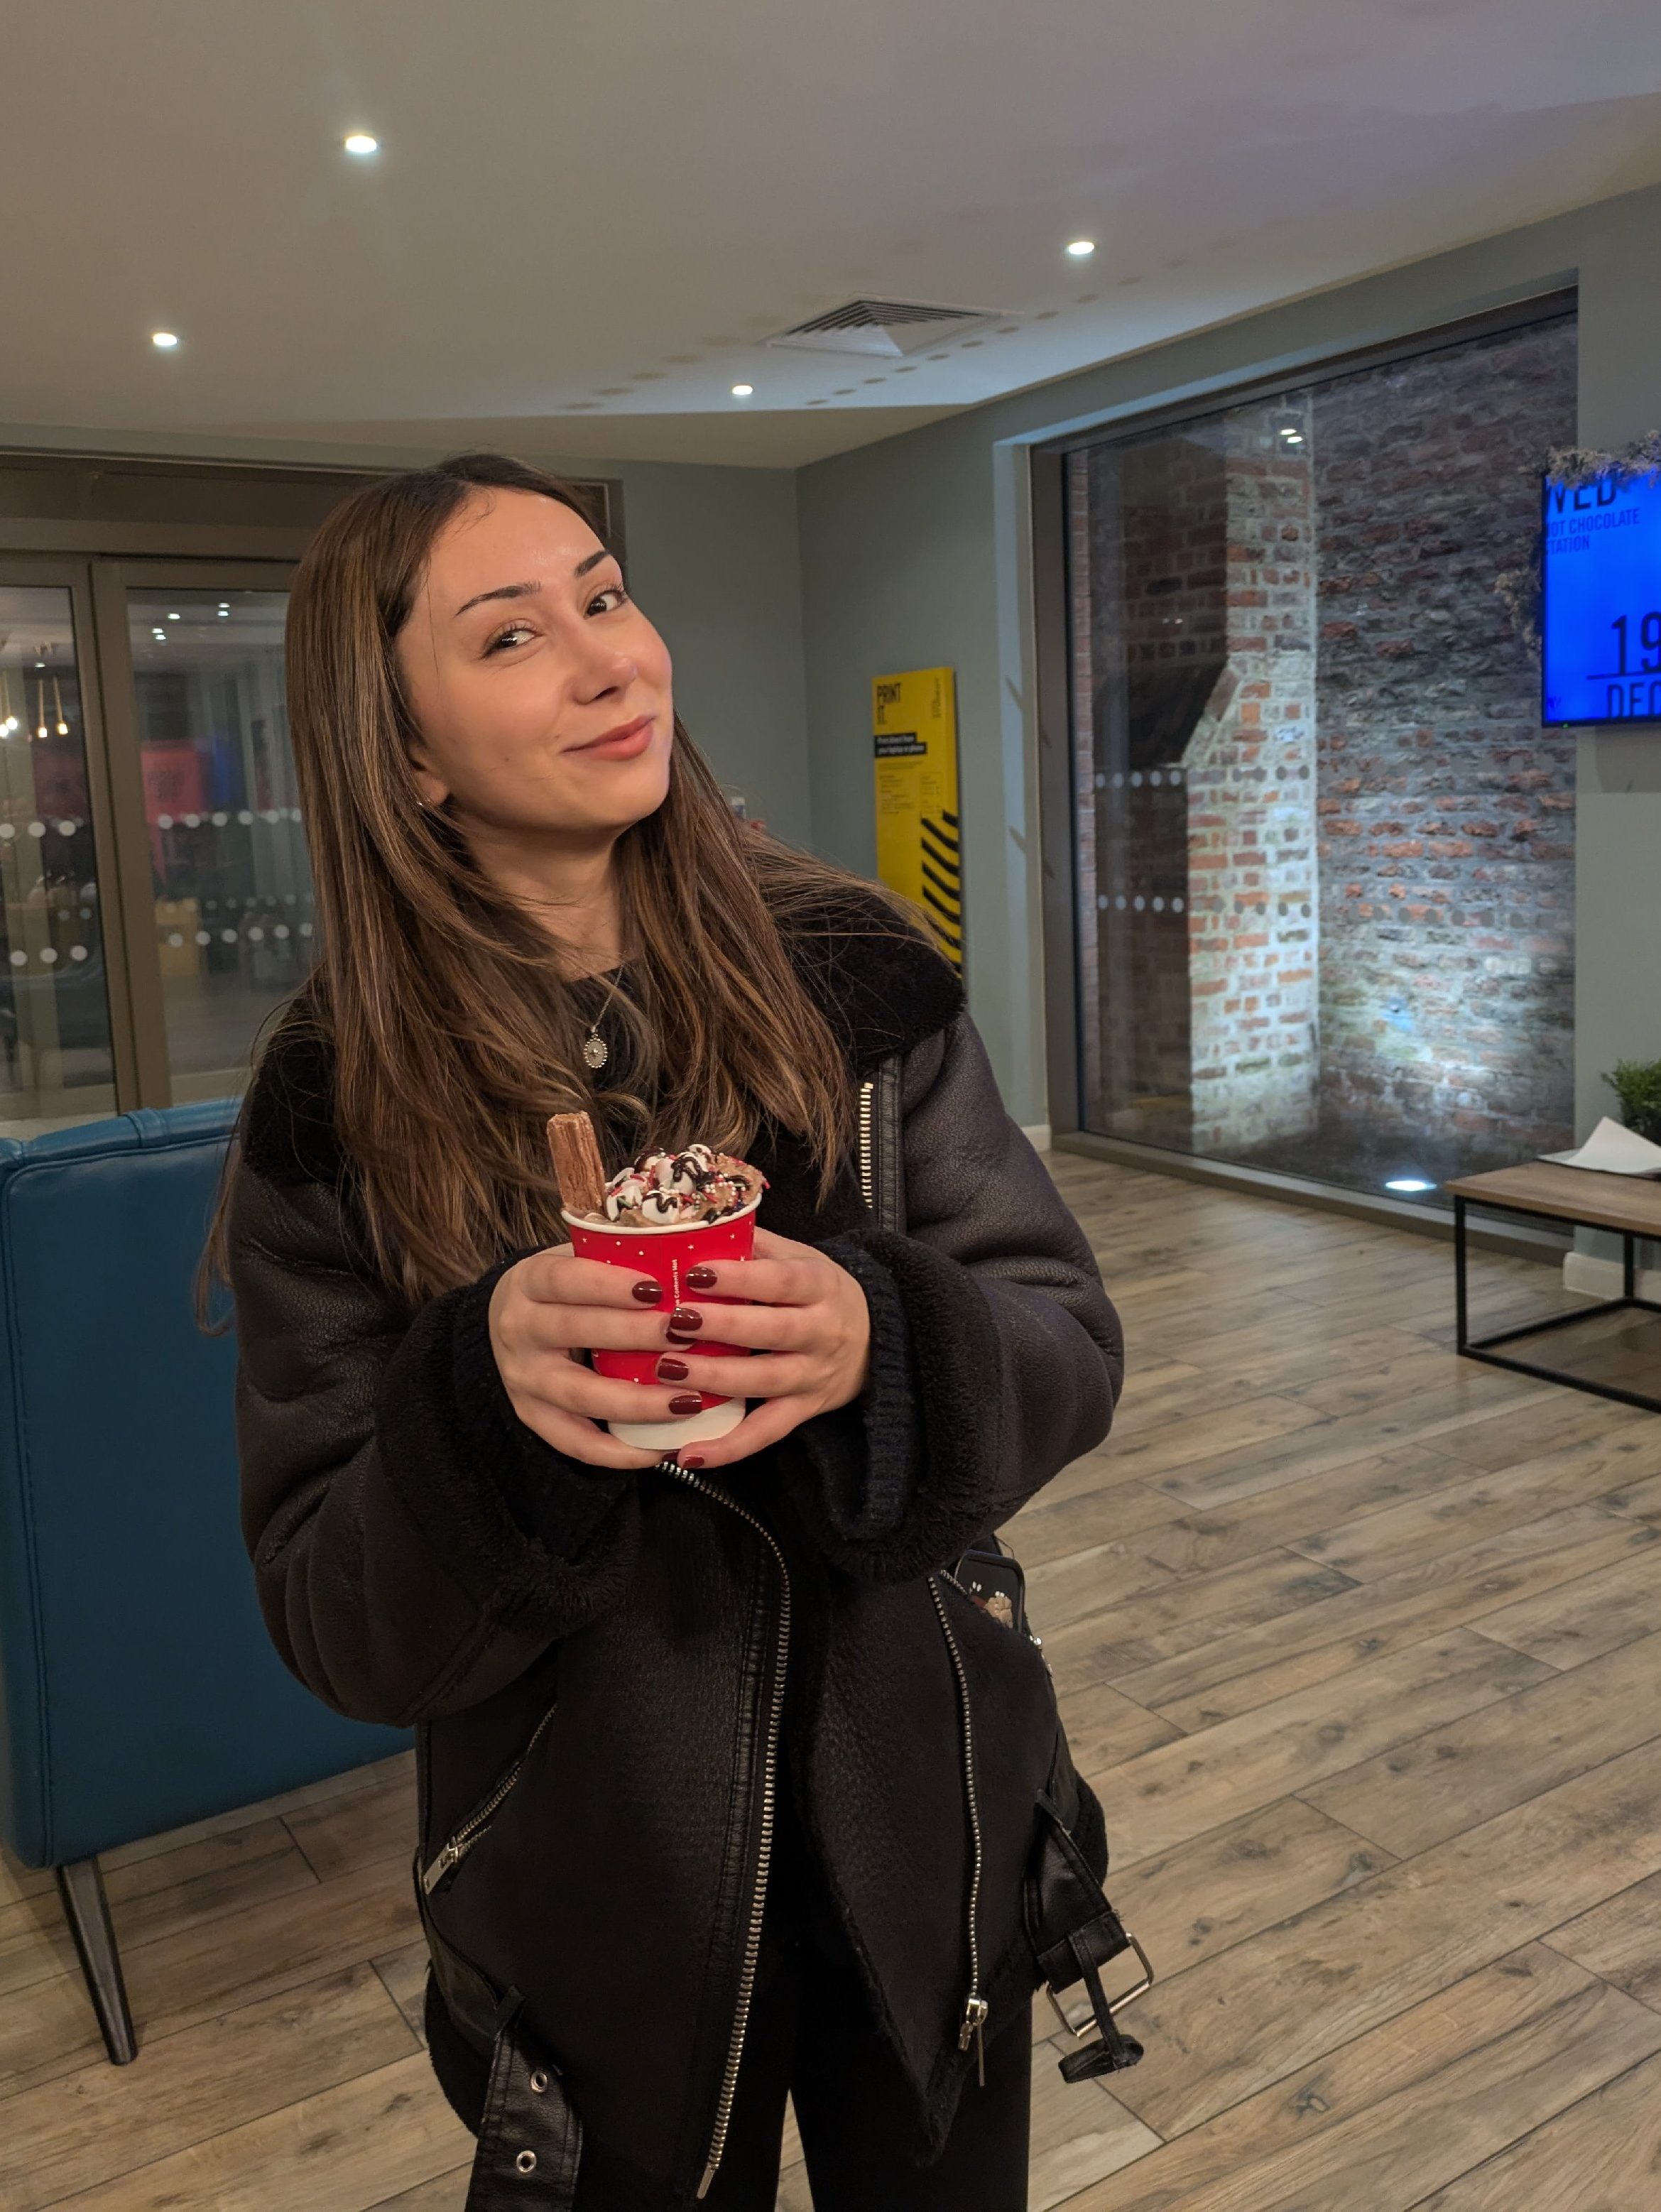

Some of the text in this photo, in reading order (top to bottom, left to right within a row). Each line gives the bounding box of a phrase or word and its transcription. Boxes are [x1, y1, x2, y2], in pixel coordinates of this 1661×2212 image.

[1569, 508, 1640, 535] CHOCOLATE
[1547, 533, 1590, 555] TATION
[1611, 611, 1661, 675] 19
